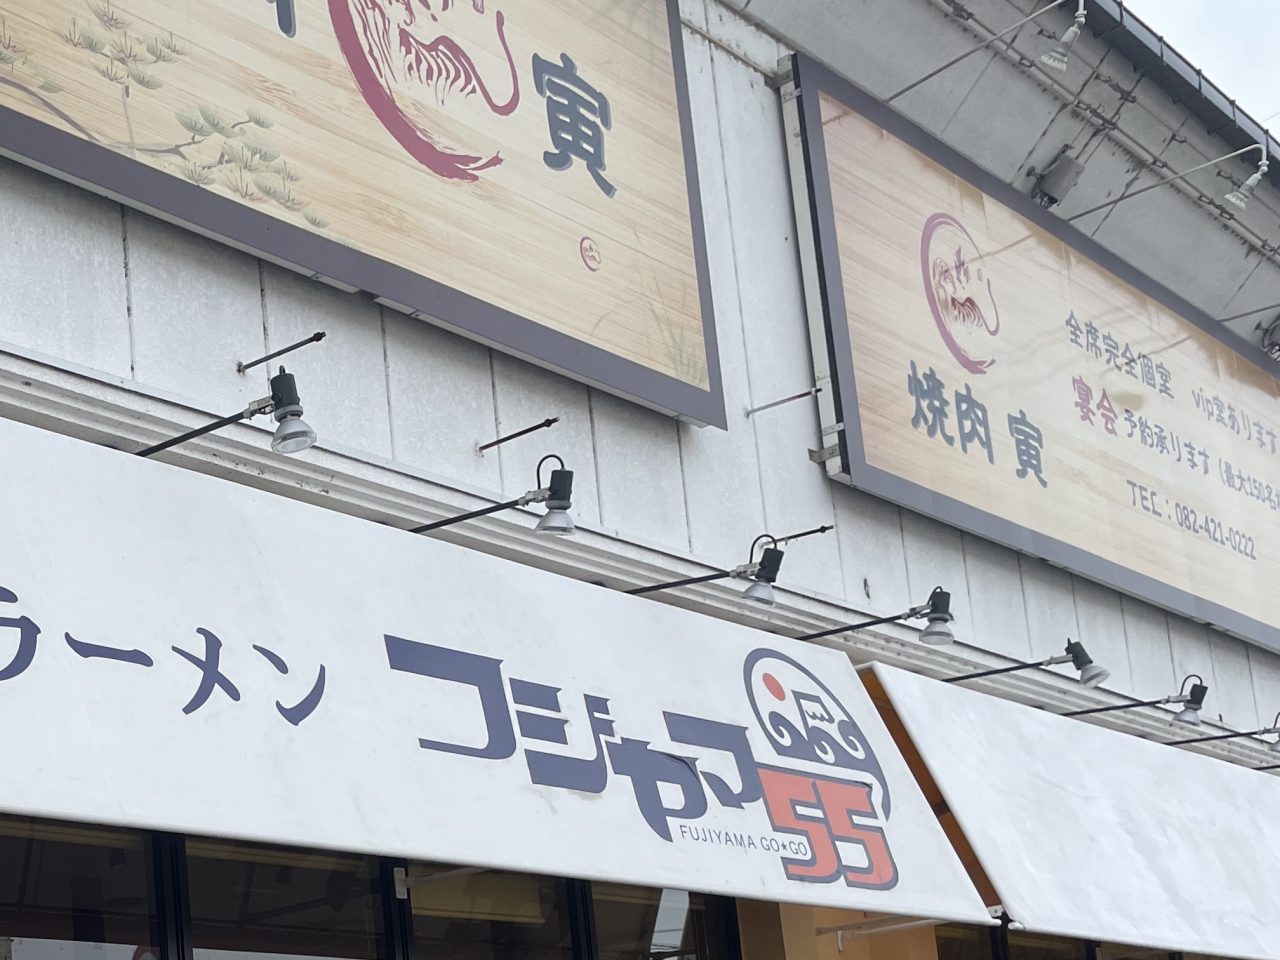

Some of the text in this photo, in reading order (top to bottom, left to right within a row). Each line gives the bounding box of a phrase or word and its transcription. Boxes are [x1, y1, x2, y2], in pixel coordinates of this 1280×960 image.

[532, 51, 617, 198] 寅
[1066, 310, 1174, 399] 全席完全個室
[907, 360, 1048, 489] 焼肉 寅
[679, 825, 758, 850] FUJIYAMA
